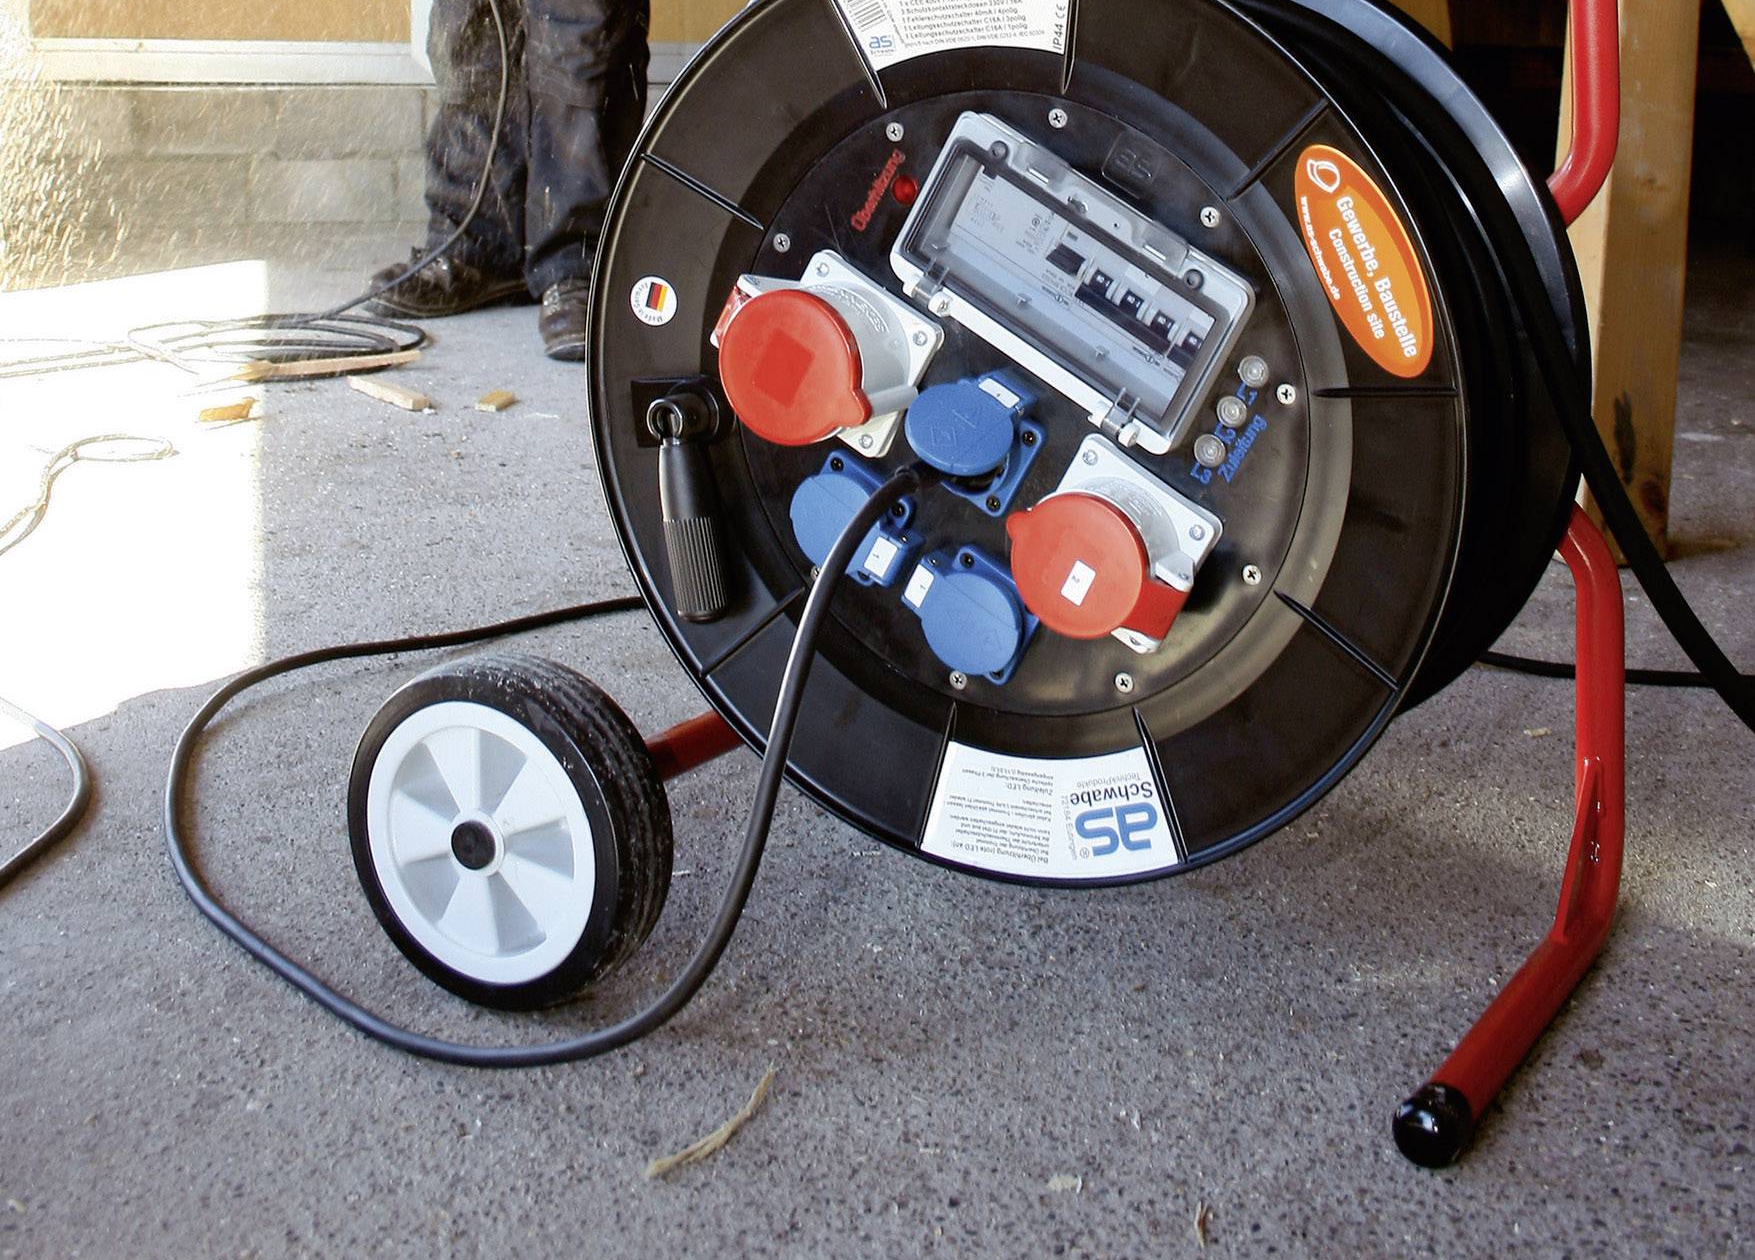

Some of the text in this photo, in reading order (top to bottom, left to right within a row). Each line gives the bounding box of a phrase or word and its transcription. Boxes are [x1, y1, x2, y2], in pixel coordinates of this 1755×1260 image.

[1053, 23, 1063, 50] IP44
[1300, 196, 1341, 301] www.as-schwabe.de
[1328, 227, 1385, 340] Construction site
[1336, 196, 1418, 358] Gewerbe, Baustelle
[1069, 781, 1153, 807] Schwabe
[1075, 802, 1158, 857] as
